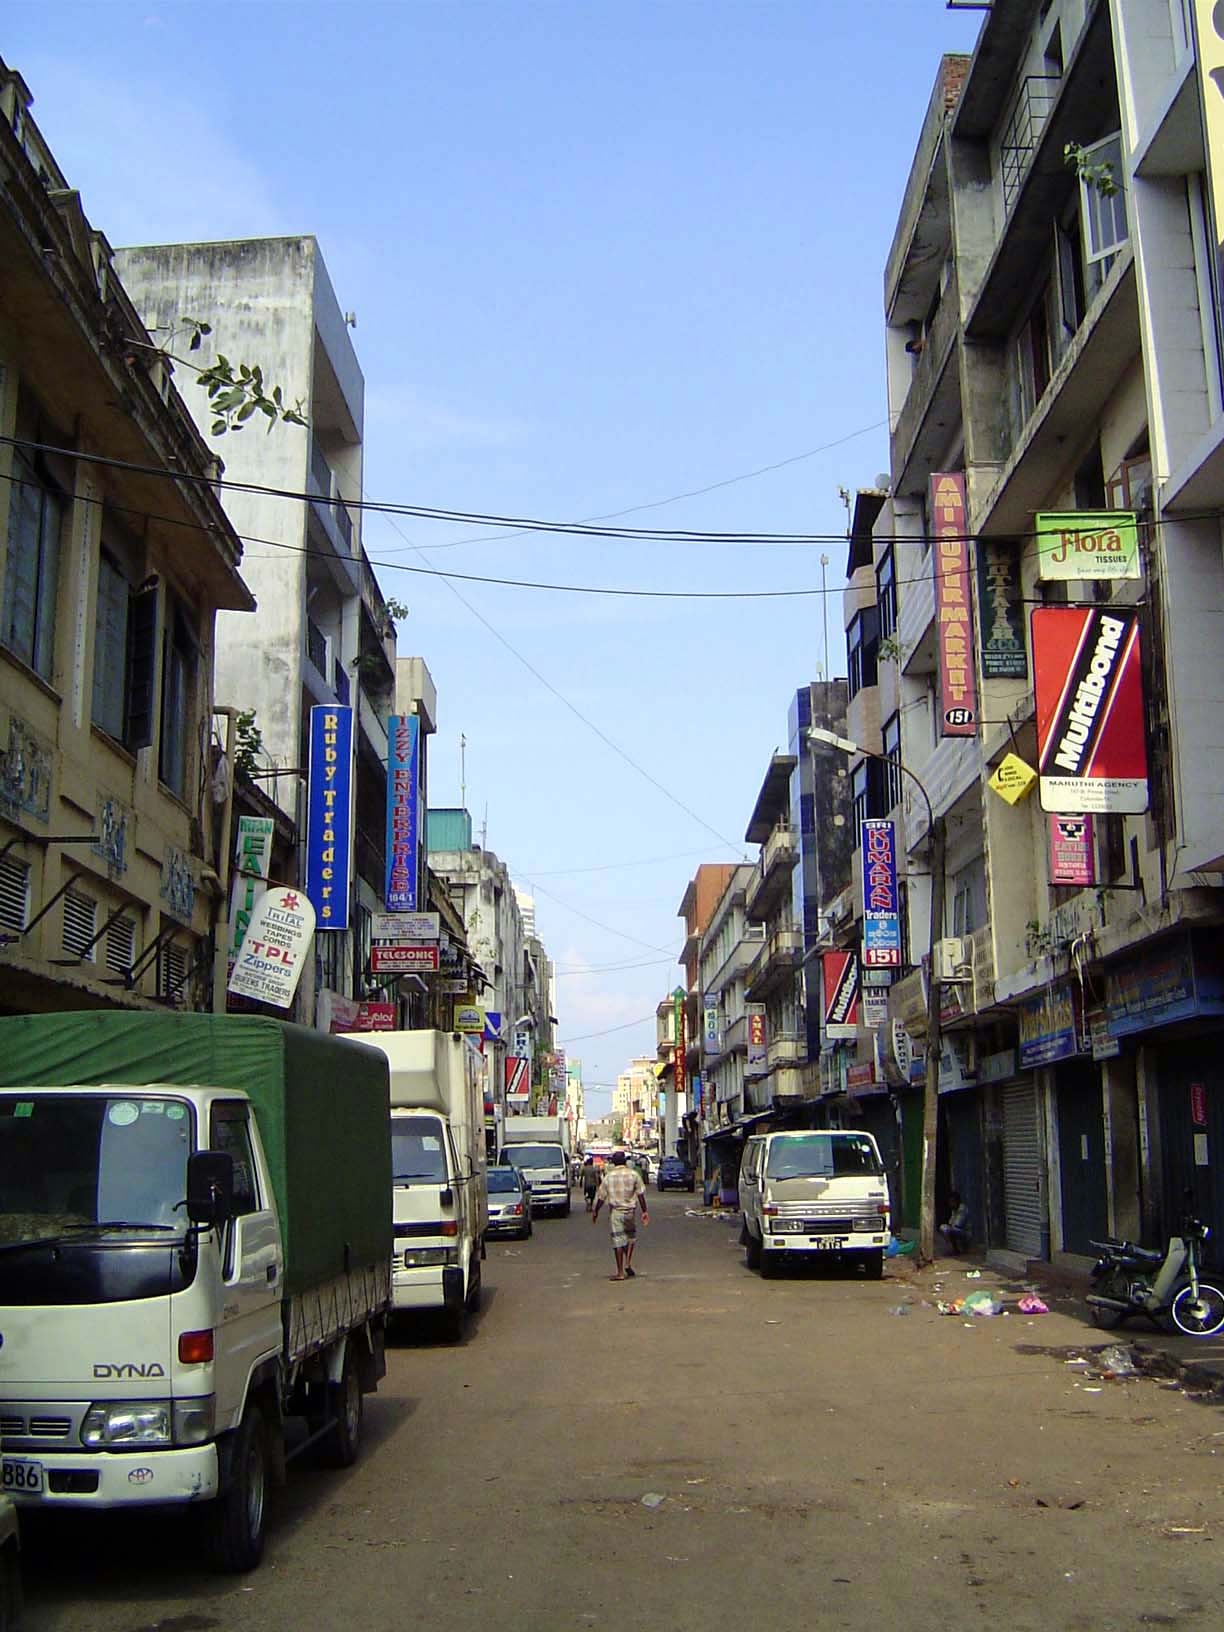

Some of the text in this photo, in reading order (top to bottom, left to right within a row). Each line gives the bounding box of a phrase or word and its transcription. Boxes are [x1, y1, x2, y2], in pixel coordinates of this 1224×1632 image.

[1051, 528, 1123, 563] Flora
[1095, 555, 1127, 563] TISSUES
[934, 478, 968, 700] AMI SUPER MARKET
[1054, 615, 1125, 772] Multibond
[949, 710, 969, 723] 151
[323, 714, 338, 781] Ruby
[394, 714, 410, 762] IZZY
[1049, 780, 1095, 788] MARUTHI
[391, 769, 413, 892] ENTERPRISE
[322, 790, 337, 918] Traders
[867, 829, 893, 909] KUMARAN
[865, 910, 897, 920] Traders
[262, 935, 292, 948] CORDS
[266, 929, 293, 942] TAPES
[243, 953, 292, 977] Zippers
[376, 951, 434, 960] TELESONIC
[869, 949, 898, 964] 151
[676, 1050, 684, 1092] PLAZA
[93, 1363, 165, 1378] DYNA
